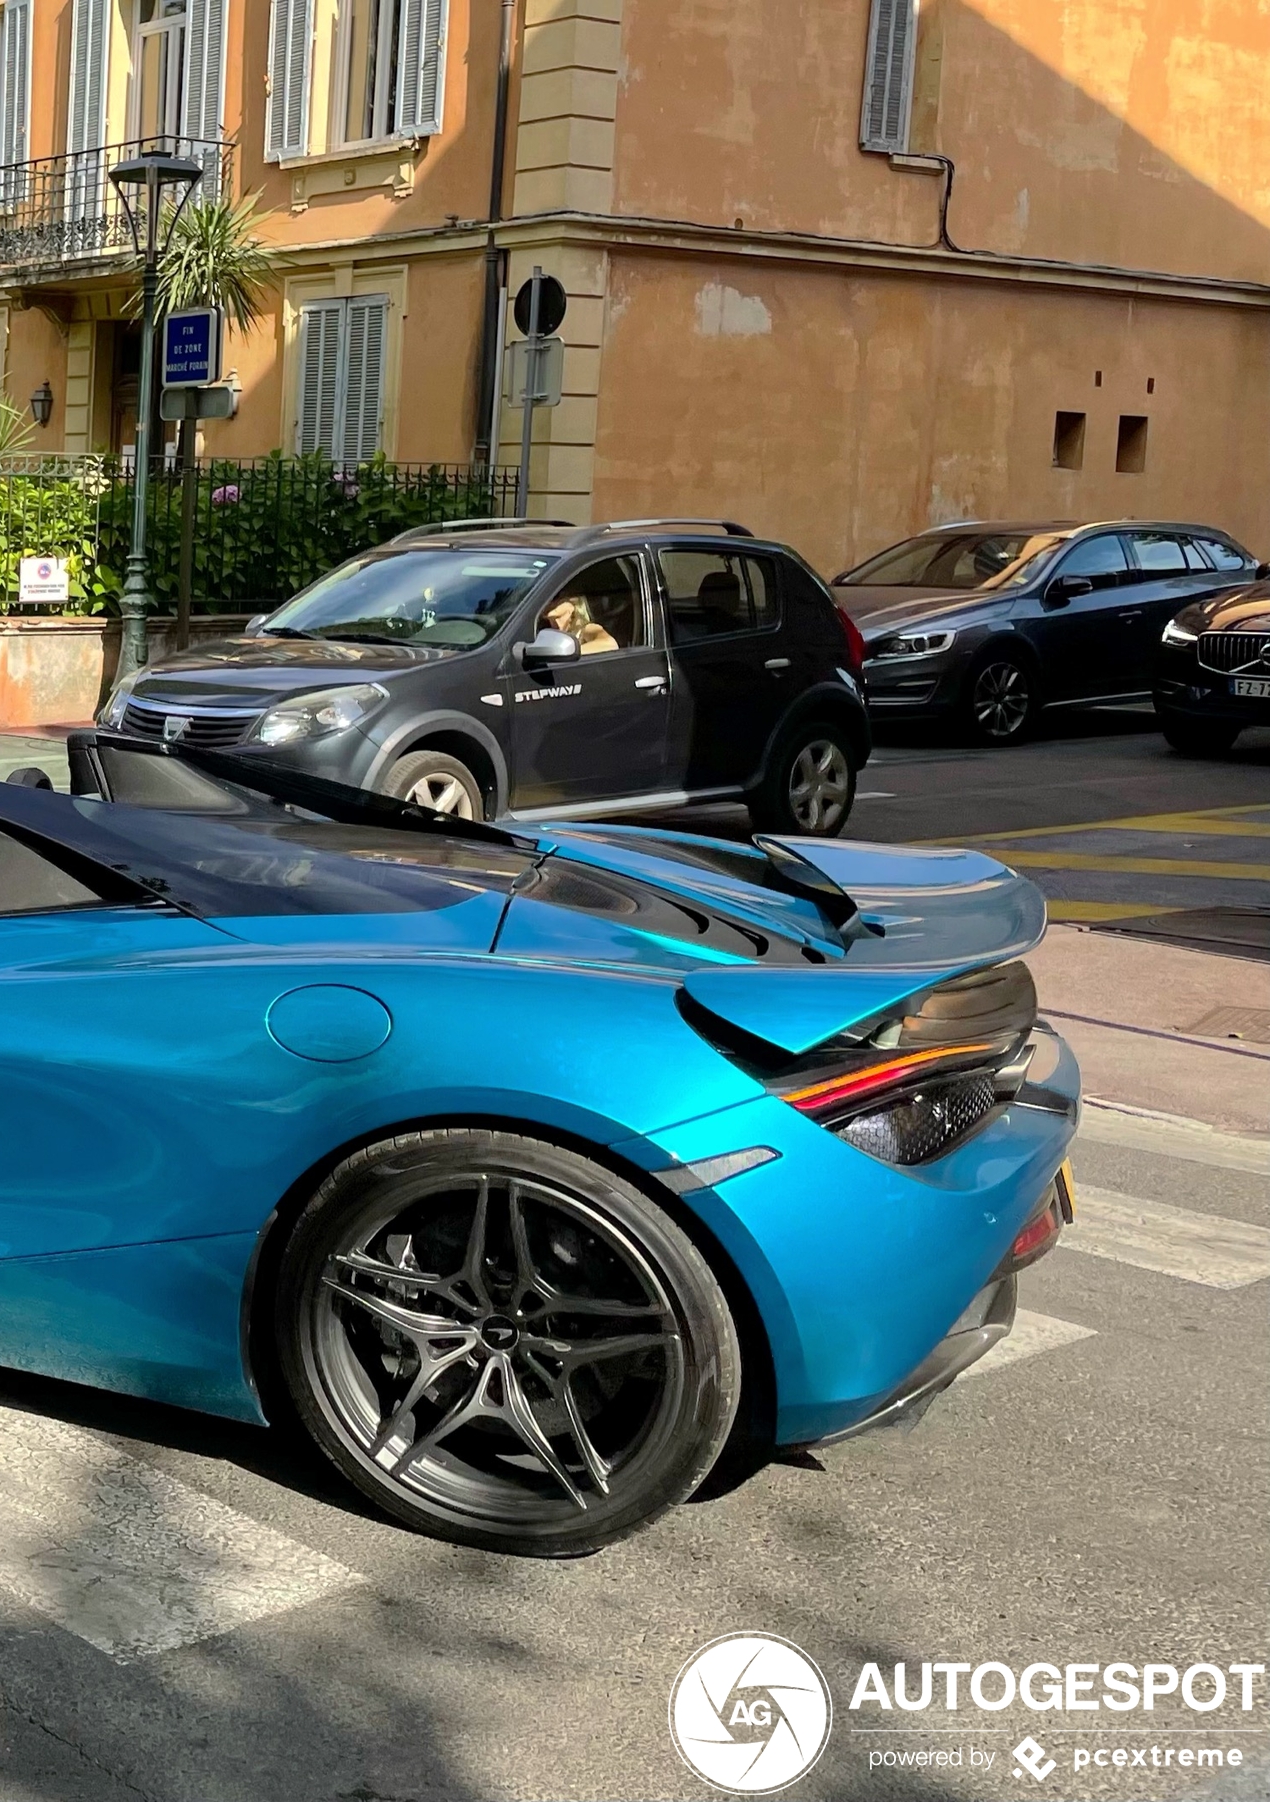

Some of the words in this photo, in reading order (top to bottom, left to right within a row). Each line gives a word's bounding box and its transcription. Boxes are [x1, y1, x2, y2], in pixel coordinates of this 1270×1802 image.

[182, 326, 194, 335] FIN
[174, 345, 183, 354] DE
[185, 343, 202, 354] ZONE
[189, 361, 209, 371] FORAIN
[515, 685, 574, 702] STEPWAY
[1237, 681, 1270, 697] FZ-7
